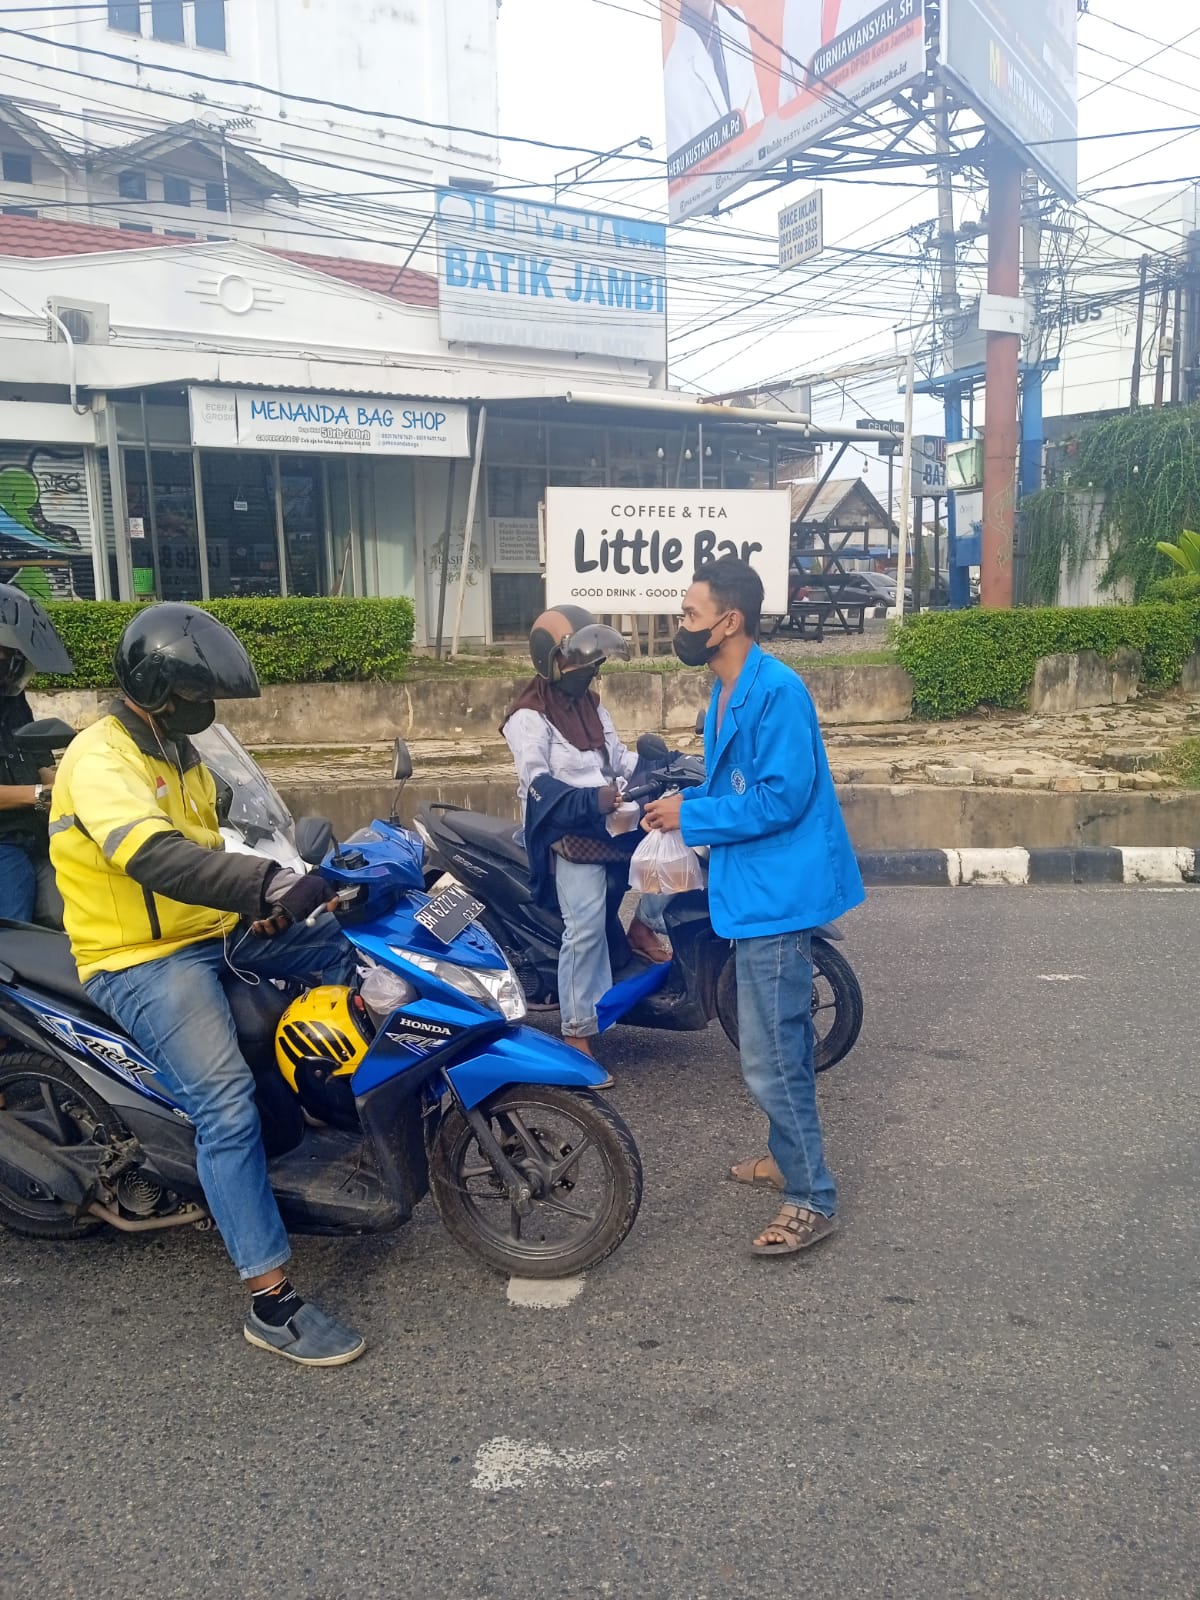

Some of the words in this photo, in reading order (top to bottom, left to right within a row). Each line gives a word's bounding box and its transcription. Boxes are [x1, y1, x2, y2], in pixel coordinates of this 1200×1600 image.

[814, 8, 897, 76] KURNIAWANSYAH,
[900, 0, 913, 20] SH
[685, 131, 721, 169] KUSTANTO,
[780, 208, 798, 231] SPACE
[798, 197, 817, 221] IKLAN
[445, 244, 554, 298] BATIK
[565, 262, 664, 313] JAMBI
[250, 400, 350, 425] MENANDA
[357, 407, 394, 427] BAG
[401, 410, 447, 431] SHOP
[320, 427, 371, 441] 50rb-200rb
[611, 505, 676, 518] COFFEE
[682, 507, 692, 518] &
[698, 506, 728, 519] TEA
[574, 528, 684, 575] Little
[693, 529, 763, 566] Bar
[571, 588, 603, 597] GOOD
[606, 588, 636, 598] DRINK
[646, 588, 677, 598] GOOD
[416, 911, 439, 929] BH
[430, 894, 457, 917] 6272
[399, 1017, 452, 1036] HONDA
